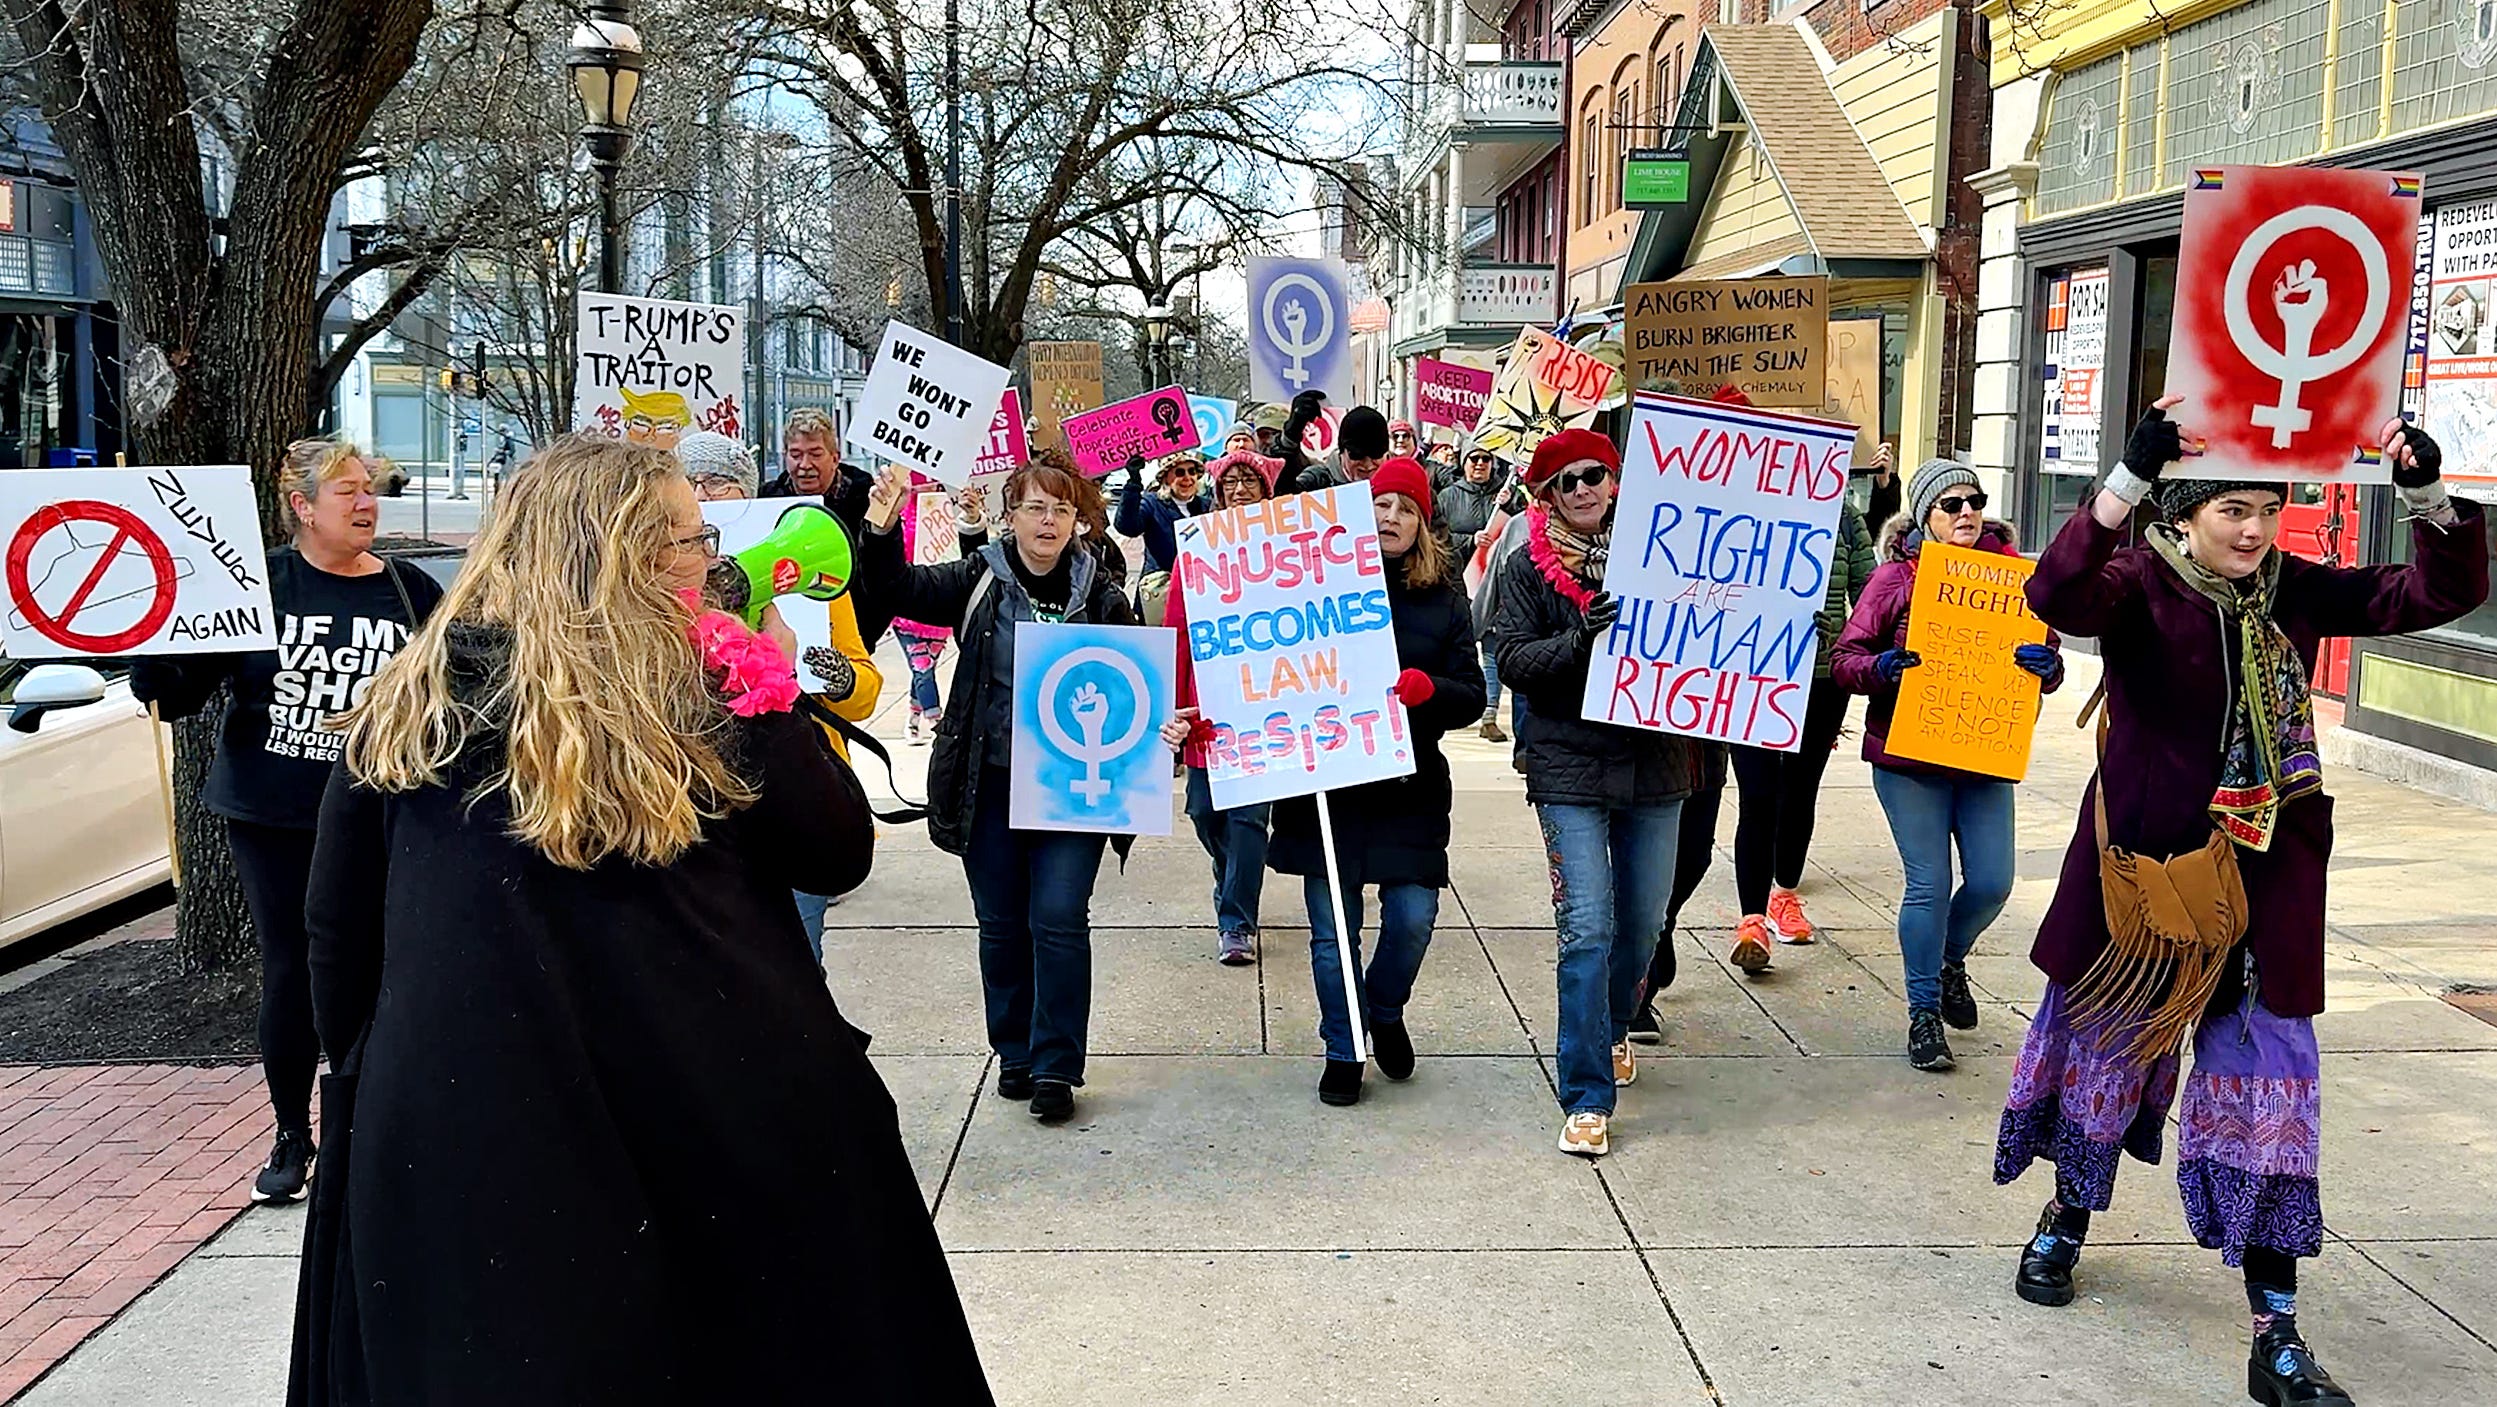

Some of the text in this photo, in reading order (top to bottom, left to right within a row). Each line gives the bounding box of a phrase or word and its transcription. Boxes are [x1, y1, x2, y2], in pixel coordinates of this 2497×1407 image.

[2442, 202, 2497, 228] REDEVEL
[2410, 212, 2434, 350] 717.850.TRUE
[2444, 254, 2478, 274] WITH
[1634, 288, 1814, 317] ANGRY WOMEN
[2071, 282, 2106, 319] FOR SA
[588, 304, 735, 345] T-RUMP'S
[1636, 323, 1797, 350] BURN BRIGHTER
[637, 334, 666, 362] A
[892, 340, 926, 369] WE
[1637, 358, 1699, 379] THAN
[1705, 353, 1744, 377] THE
[1753, 347, 1808, 373] SUN
[583, 353, 719, 399] TRAITOR
[1434, 369, 1472, 389] KEEP
[1540, 340, 1616, 405] RESIST
[1681, 380, 1806, 395] ORAY CHEMALY
[908, 374, 972, 419] WONT
[1420, 381, 1488, 409] ABORTION
[1420, 398, 1443, 416] SAFE
[1825, 378, 1867, 415] GA
[898, 402, 931, 429] GO
[1068, 409, 1139, 439] Celebrate.
[872, 420, 944, 468] BACK!
[1075, 426, 1146, 455] Appreciate.
[1099, 433, 1160, 466] RESPECT
[970, 455, 1017, 475] OOSE
[1644, 420, 1849, 501] WOMEN'S
[147, 469, 260, 592] NEVER
[1200, 487, 1338, 549] WHEN
[1182, 526, 1382, 604] INJUSTICE
[1642, 502, 1832, 598] RIGHTS
[1664, 578, 1750, 613] ARE
[1937, 582, 2039, 620] RIGHT
[169, 607, 262, 642] AGAIN
[281, 613, 415, 652] IF MY
[1190, 589, 1392, 662] BECOMES
[1607, 596, 1817, 682] HUMAN
[1928, 622, 1990, 647] RISE
[1924, 641, 1997, 665] STAND
[1241, 647, 1348, 703] LAW,
[1923, 659, 2029, 693] SPEAK UP
[1607, 656, 1800, 749] RIGHTS
[1920, 685, 2025, 720] SILENCE
[269, 725, 344, 750] IT WOUL
[1207, 687, 1407, 775] RESIST!
[1918, 703, 2022, 739] IS NOT
[265, 739, 339, 762] LESS REG
[1920, 725, 2022, 755] AN OPTION
